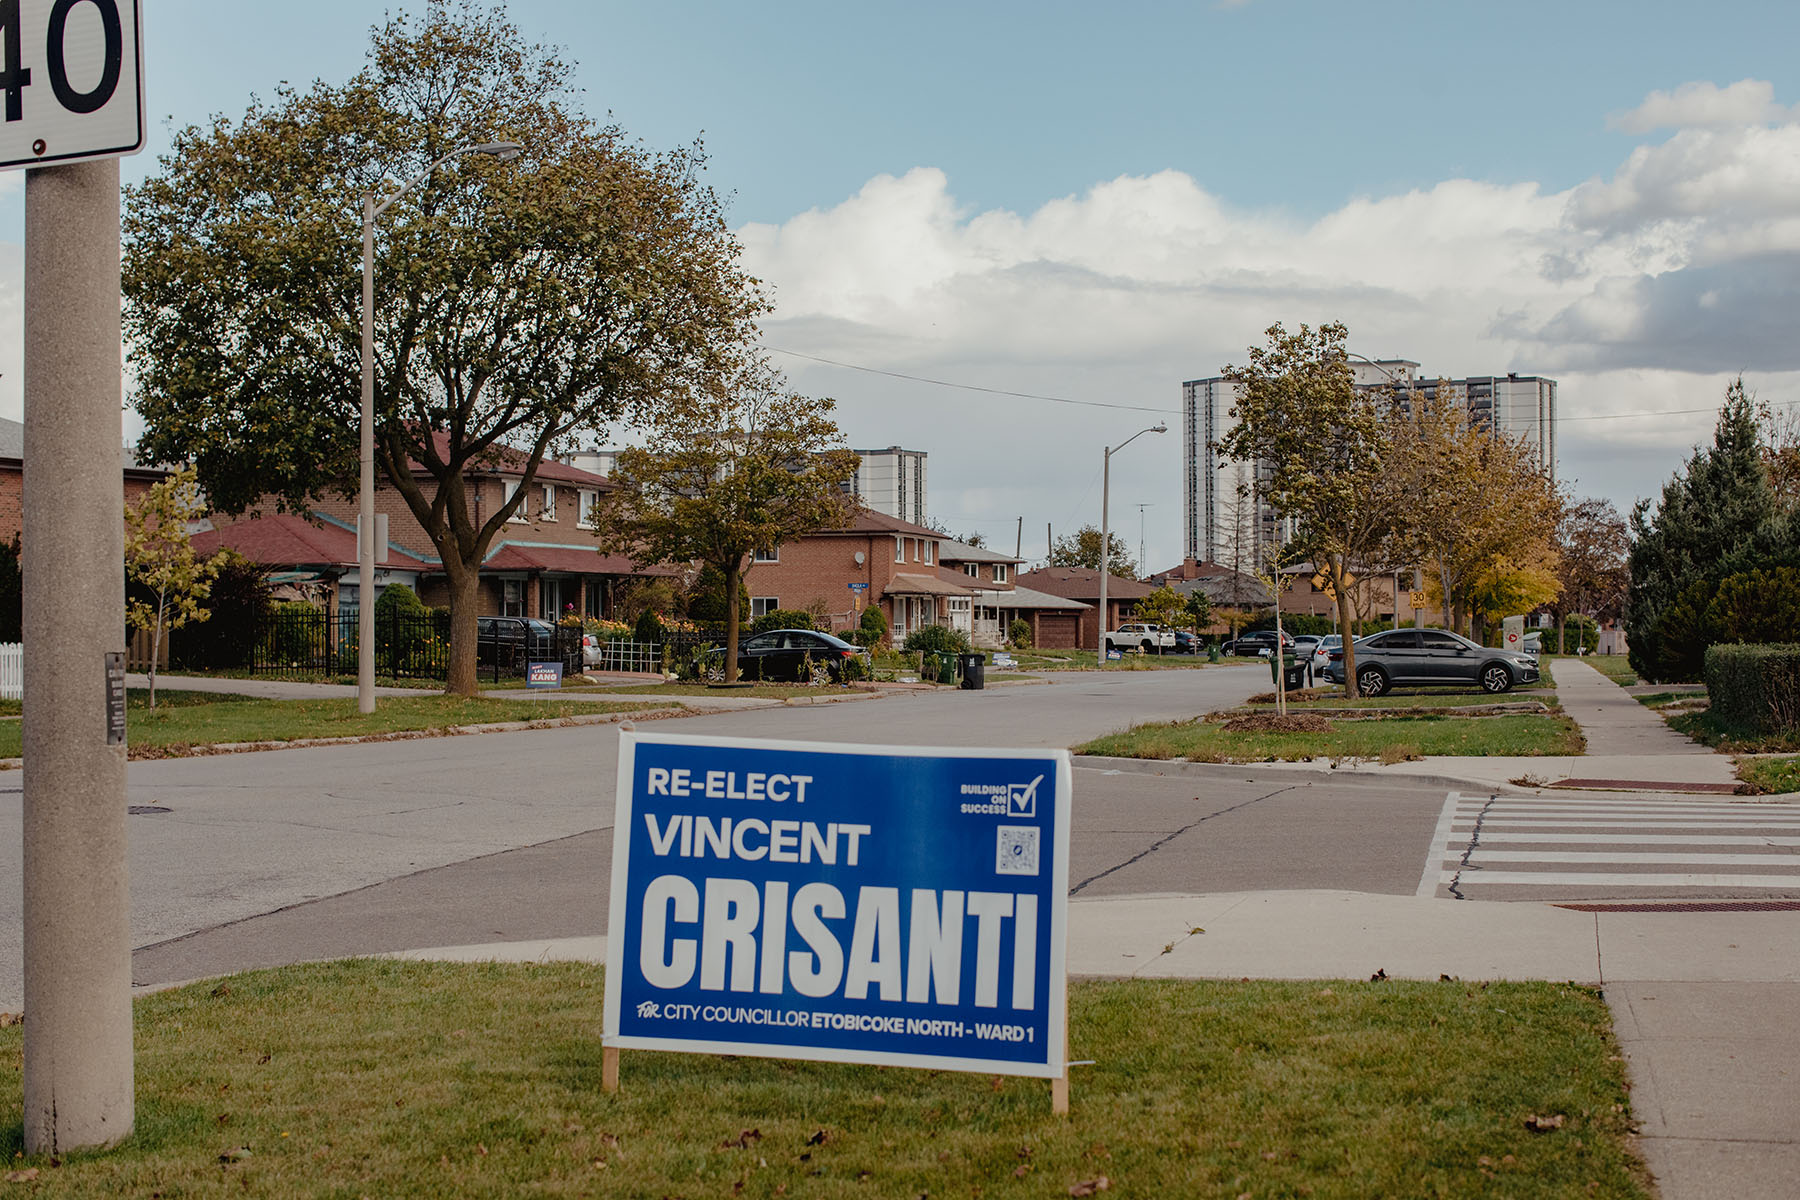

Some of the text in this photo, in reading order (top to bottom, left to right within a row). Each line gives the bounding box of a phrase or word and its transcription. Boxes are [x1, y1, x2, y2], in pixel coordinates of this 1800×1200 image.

[0, 0, 123, 122] 40
[1413, 592, 1424, 602] 30
[647, 767, 813, 803] RE-ELECT
[960, 784, 1007, 795] BUILDING
[991, 795, 1007, 805] ON
[960, 803, 1007, 815] SUCCESS
[644, 813, 872, 866] VINCENT
[639, 874, 1038, 1011] CRISANTI
[664, 1004, 702, 1021] CITY
[702, 1005, 810, 1027] COUNCILLOR
[811, 1012, 905, 1034] ETOBICOKE
[906, 1018, 964, 1038] NORTH
[975, 1023, 1025, 1042] WARD
[1026, 1026, 1034, 1043] 1
